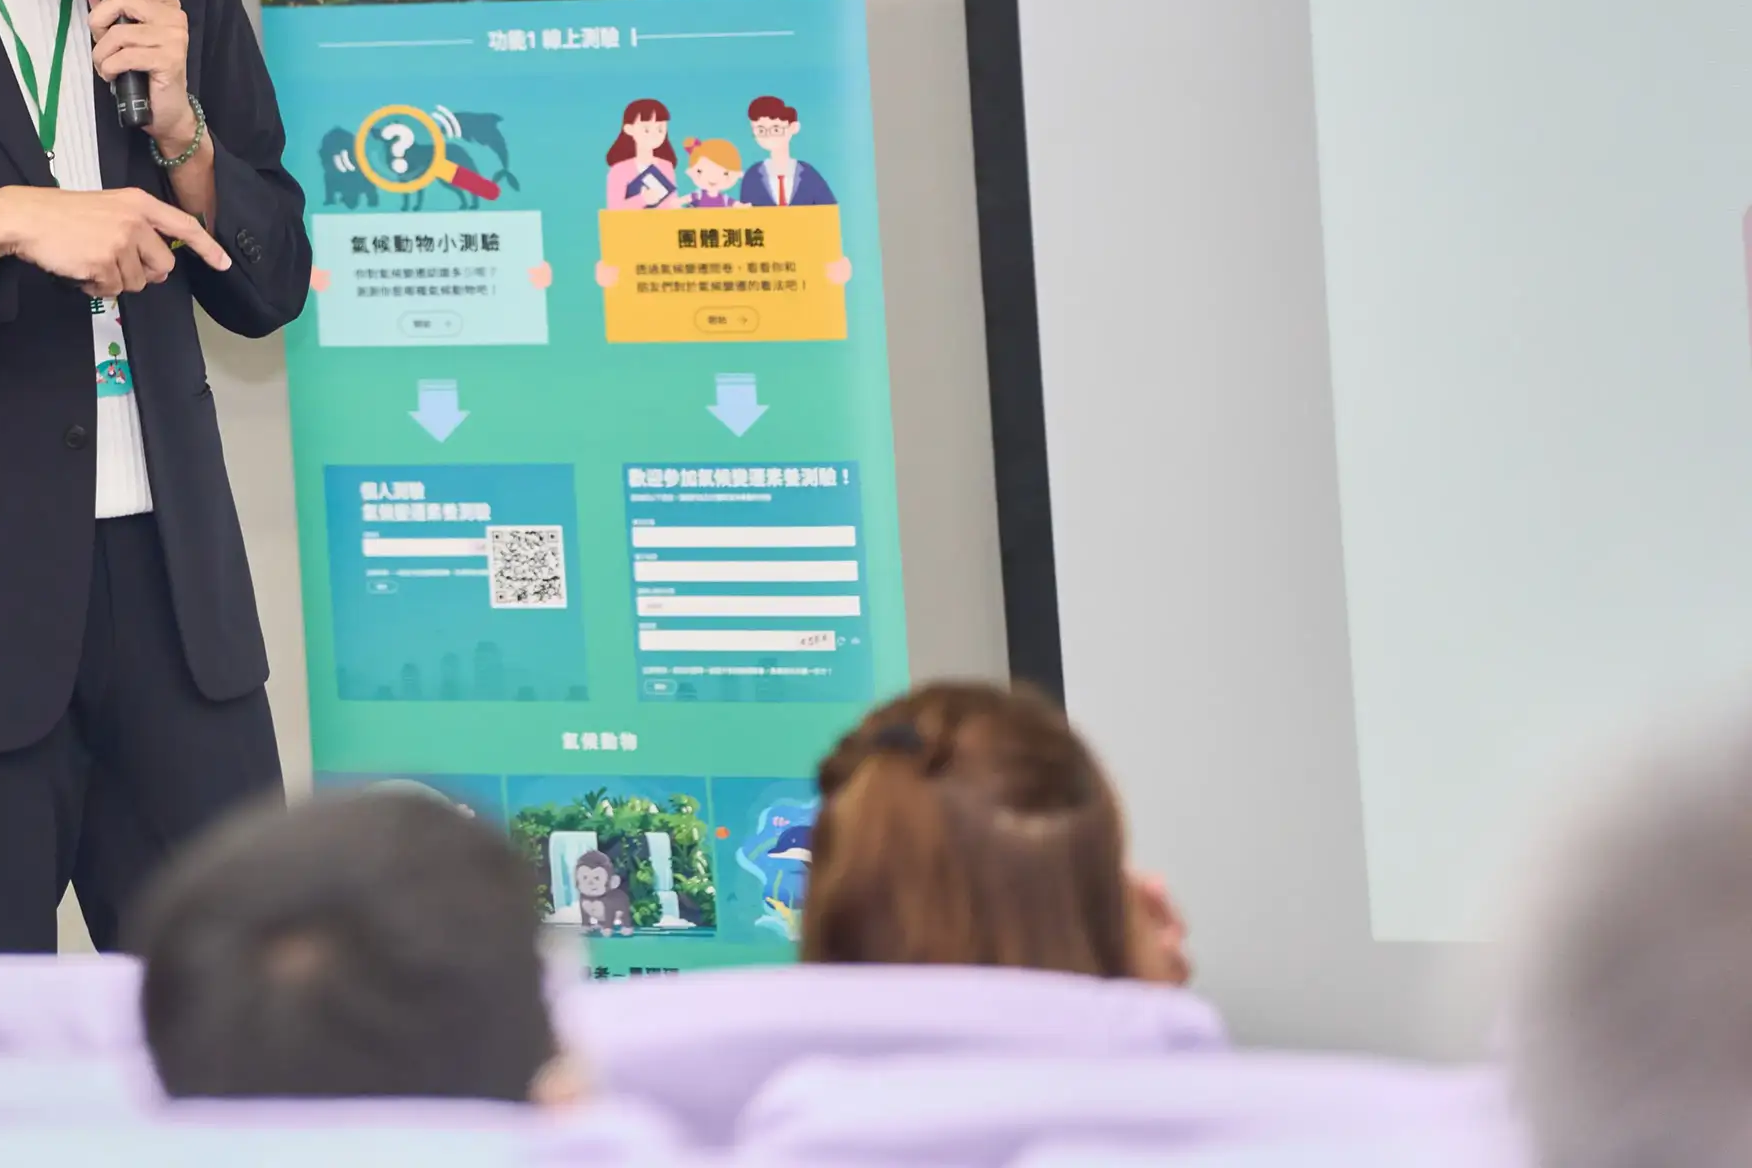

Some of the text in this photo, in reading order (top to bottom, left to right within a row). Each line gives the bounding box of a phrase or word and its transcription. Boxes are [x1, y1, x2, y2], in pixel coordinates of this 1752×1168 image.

[351, 232, 501, 255] 氣候動物小測驗
[677, 227, 766, 250] 團體測驗
